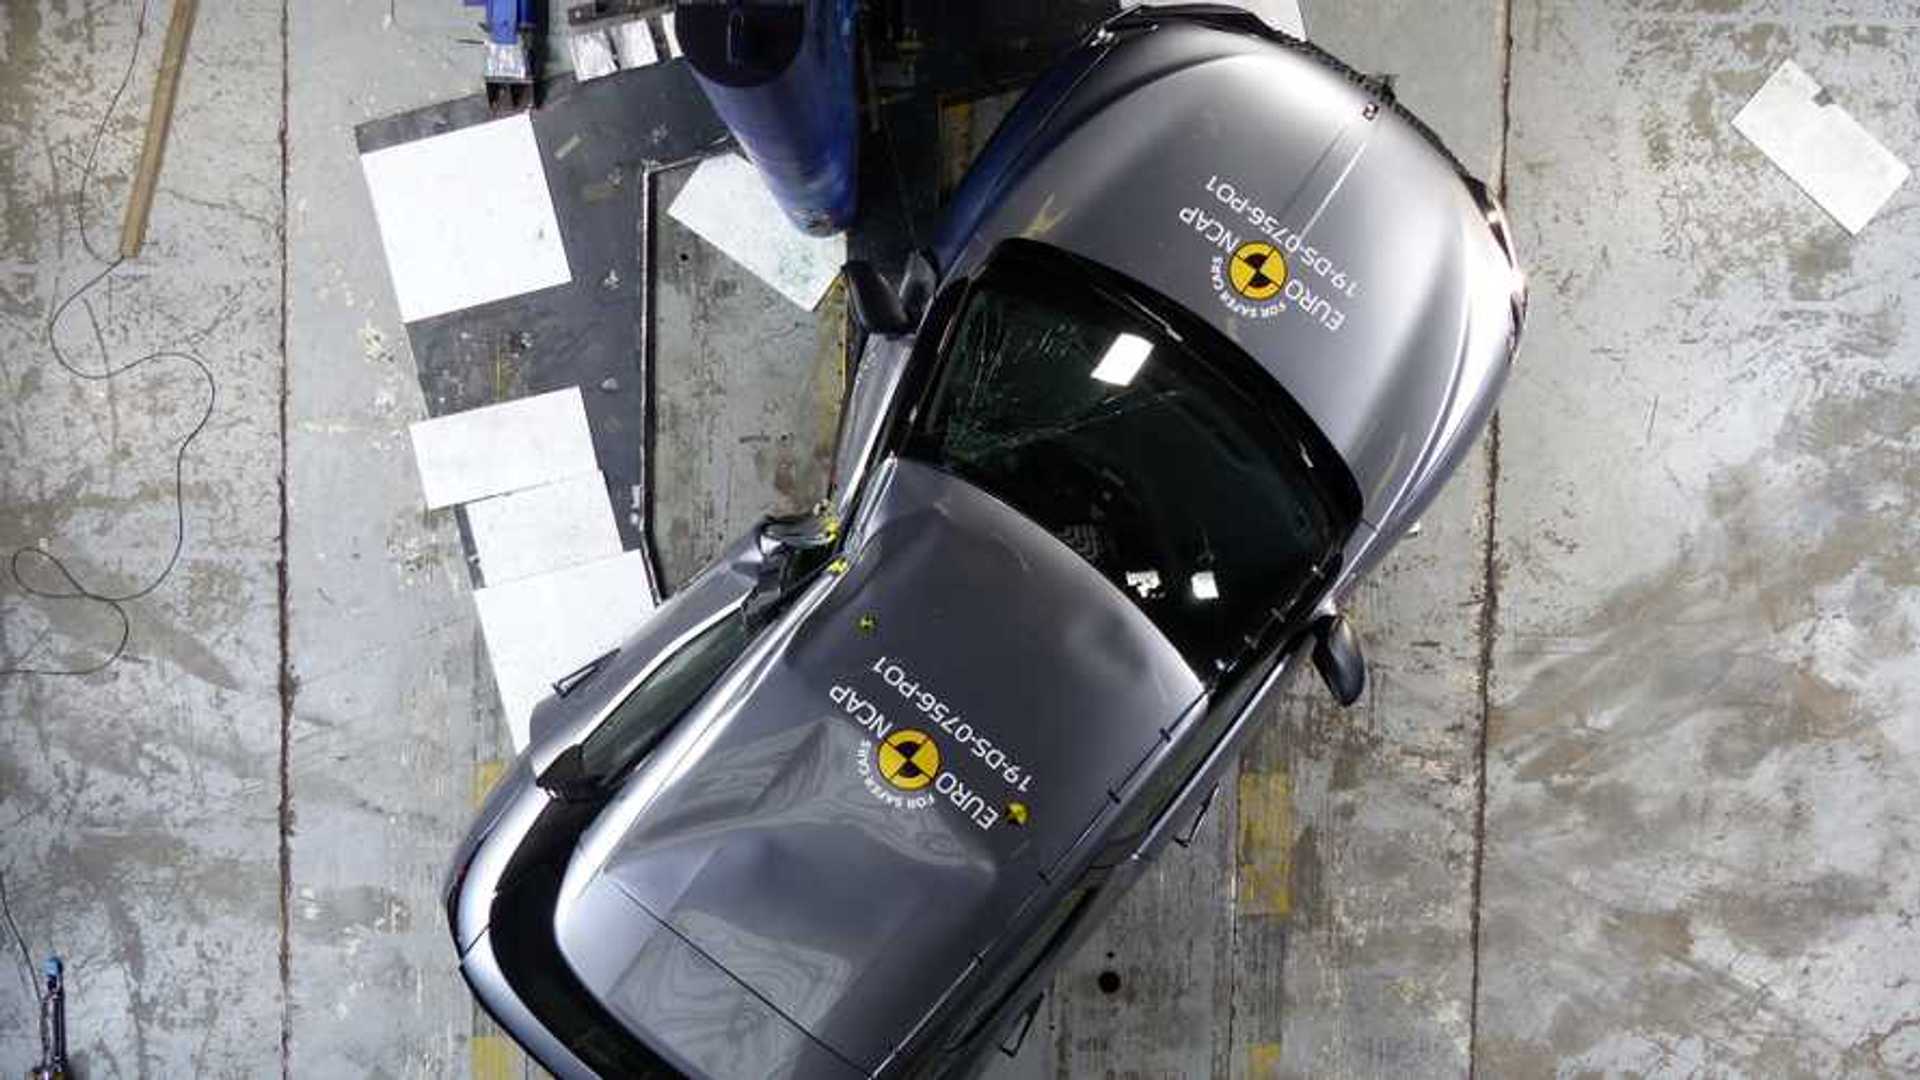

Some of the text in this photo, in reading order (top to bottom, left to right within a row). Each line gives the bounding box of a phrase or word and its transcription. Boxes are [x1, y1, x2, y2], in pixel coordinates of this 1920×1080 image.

[1179, 207, 1345, 331] EURO NCAP
[1260, 301, 1287, 318] FOR
[829, 685, 1001, 831] EURO NCAP
